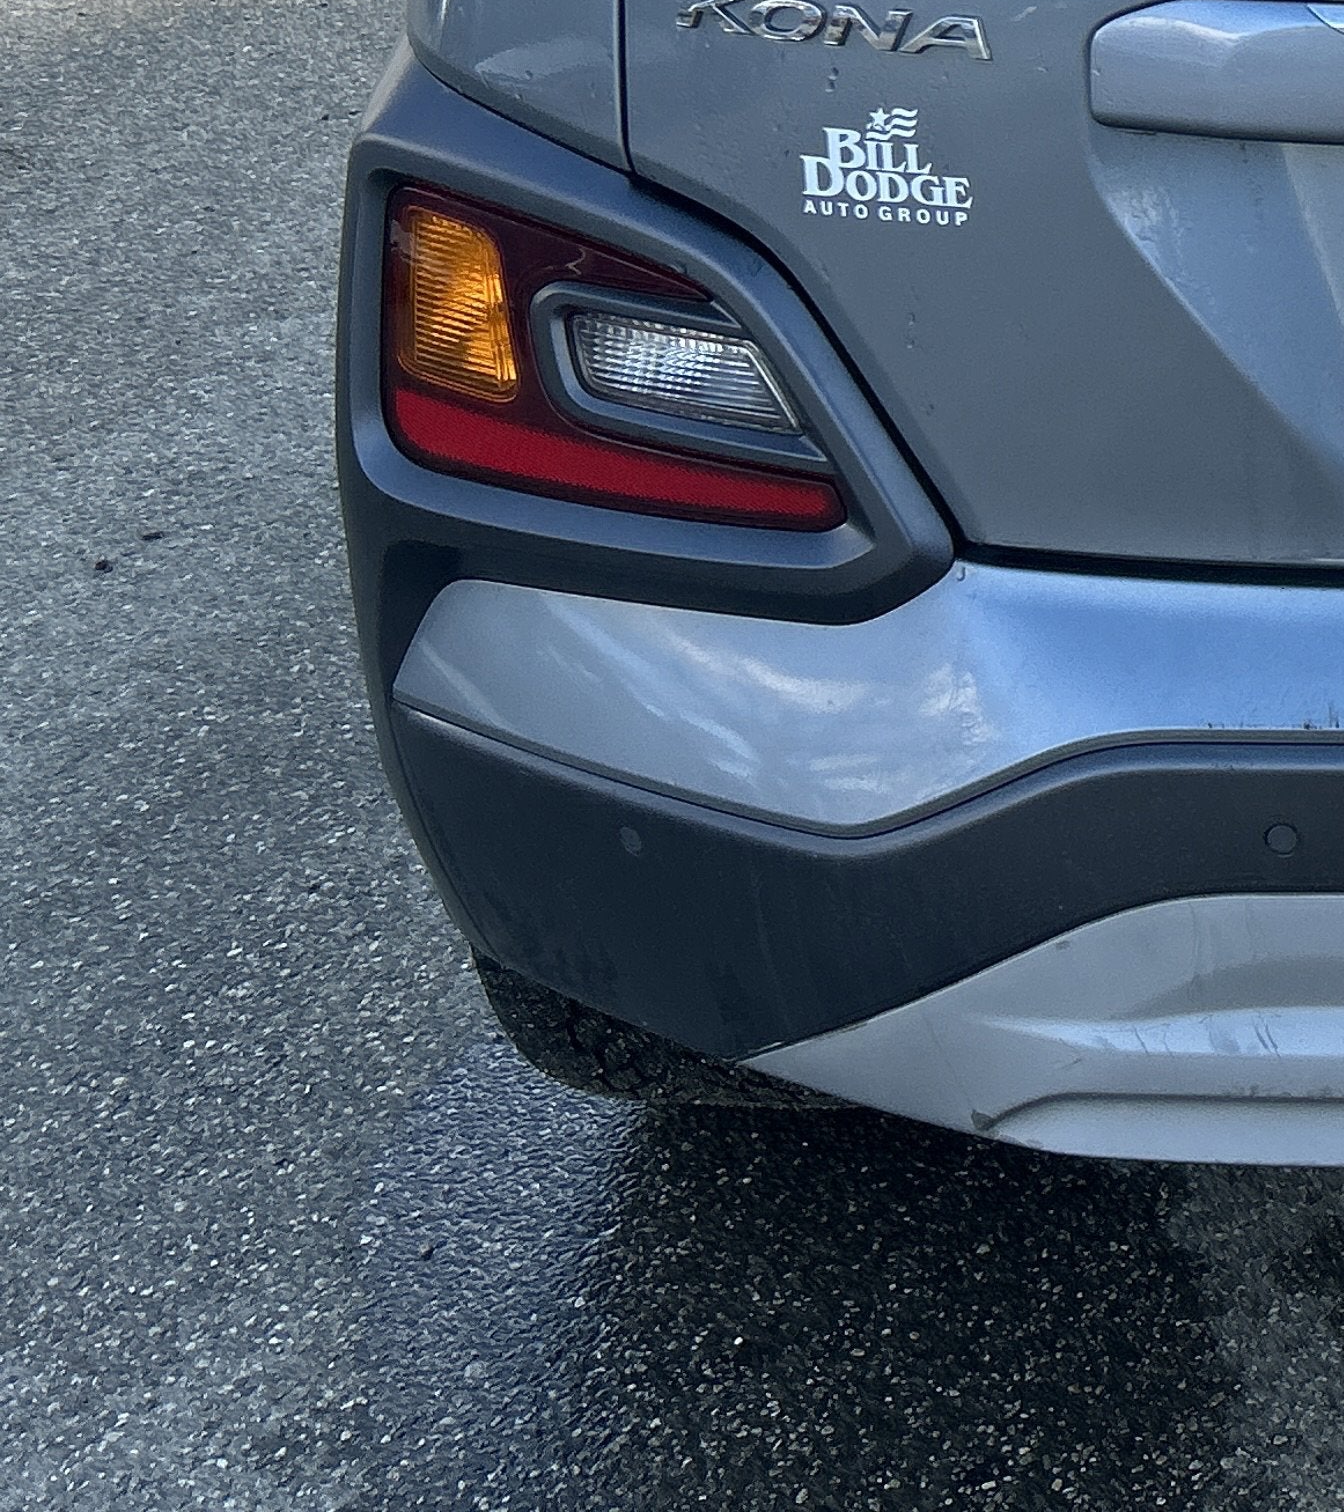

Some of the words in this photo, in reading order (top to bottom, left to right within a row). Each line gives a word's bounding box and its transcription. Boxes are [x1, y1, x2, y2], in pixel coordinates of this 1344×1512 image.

[822, 127, 932, 175] BILL
[800, 155, 973, 209] DODGE
[803, 199, 869, 221] AUTO
[878, 206, 968, 226] GROUP
